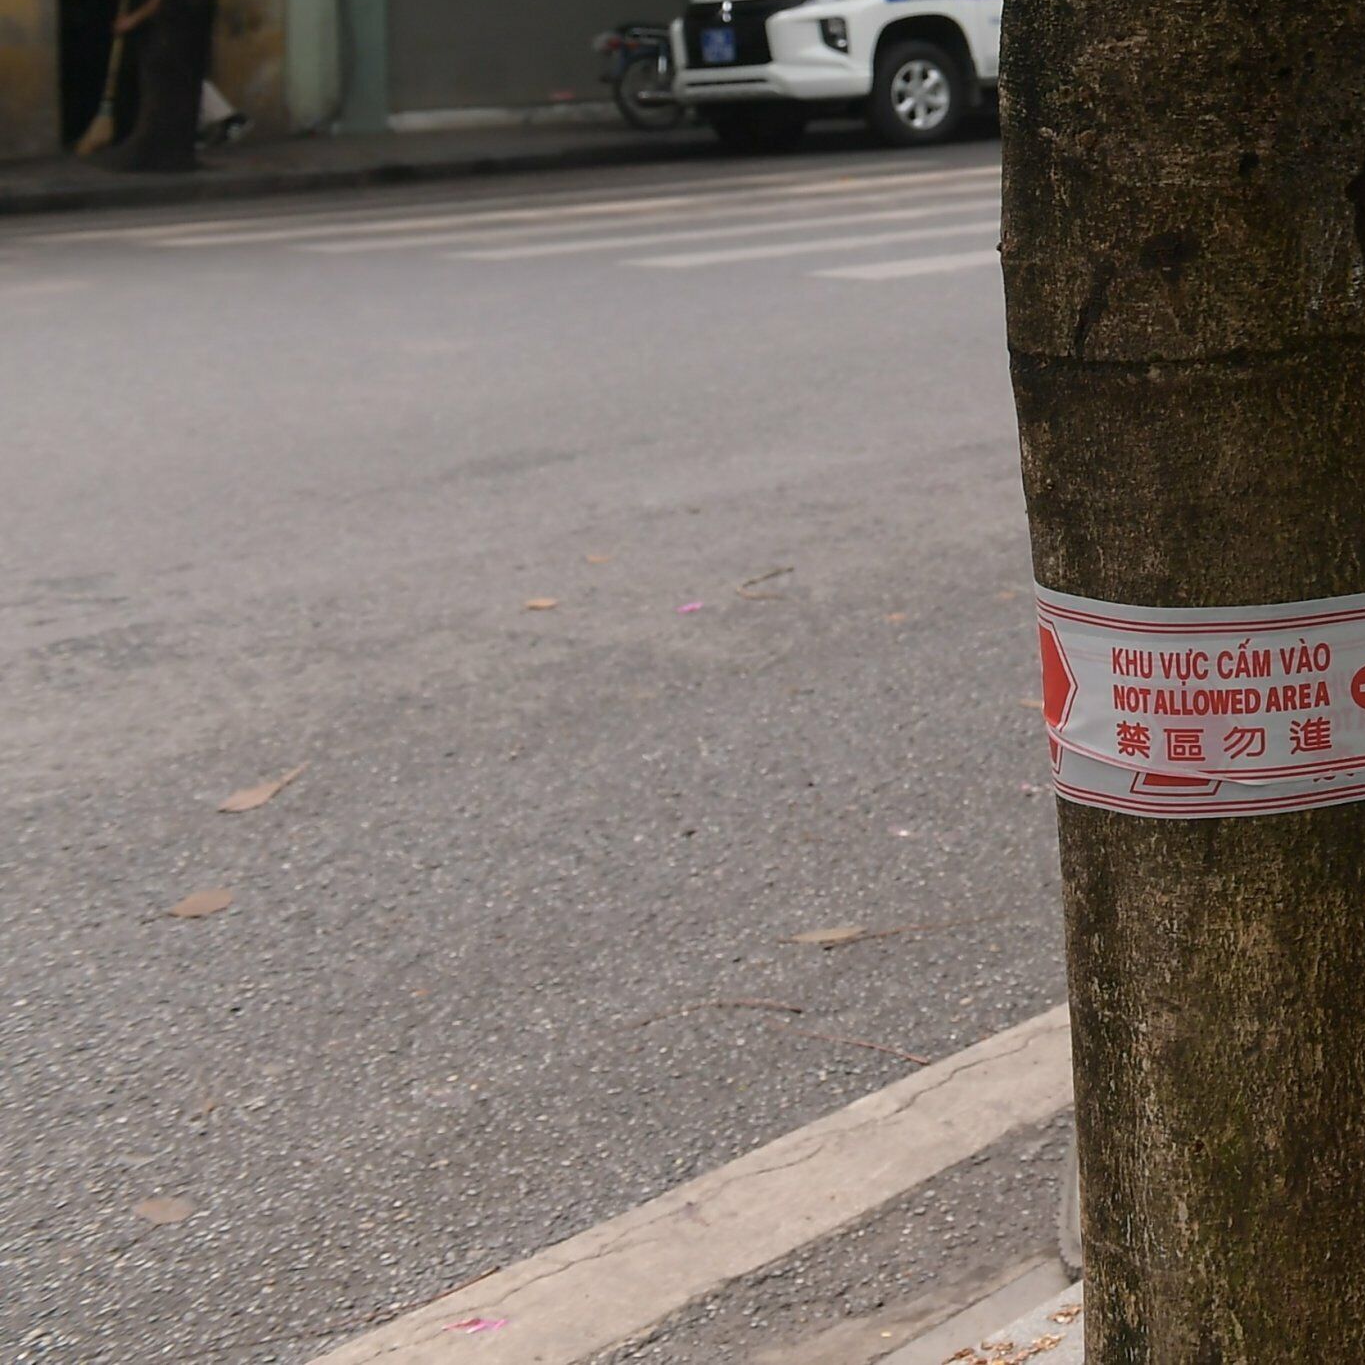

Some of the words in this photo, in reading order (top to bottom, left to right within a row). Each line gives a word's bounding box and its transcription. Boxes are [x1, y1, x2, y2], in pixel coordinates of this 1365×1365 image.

[1112, 647, 1152, 679] KHU
[1159, 648, 1209, 686] VỰC
[1217, 638, 1271, 680] CẤM
[1280, 638, 1331, 675] VÀO
[1113, 684, 1151, 714] NOT
[1154, 688, 1261, 716] ALLOWED
[1265, 681, 1330, 713] AREA
[1116, 716, 1332, 761] 禁區勿進
